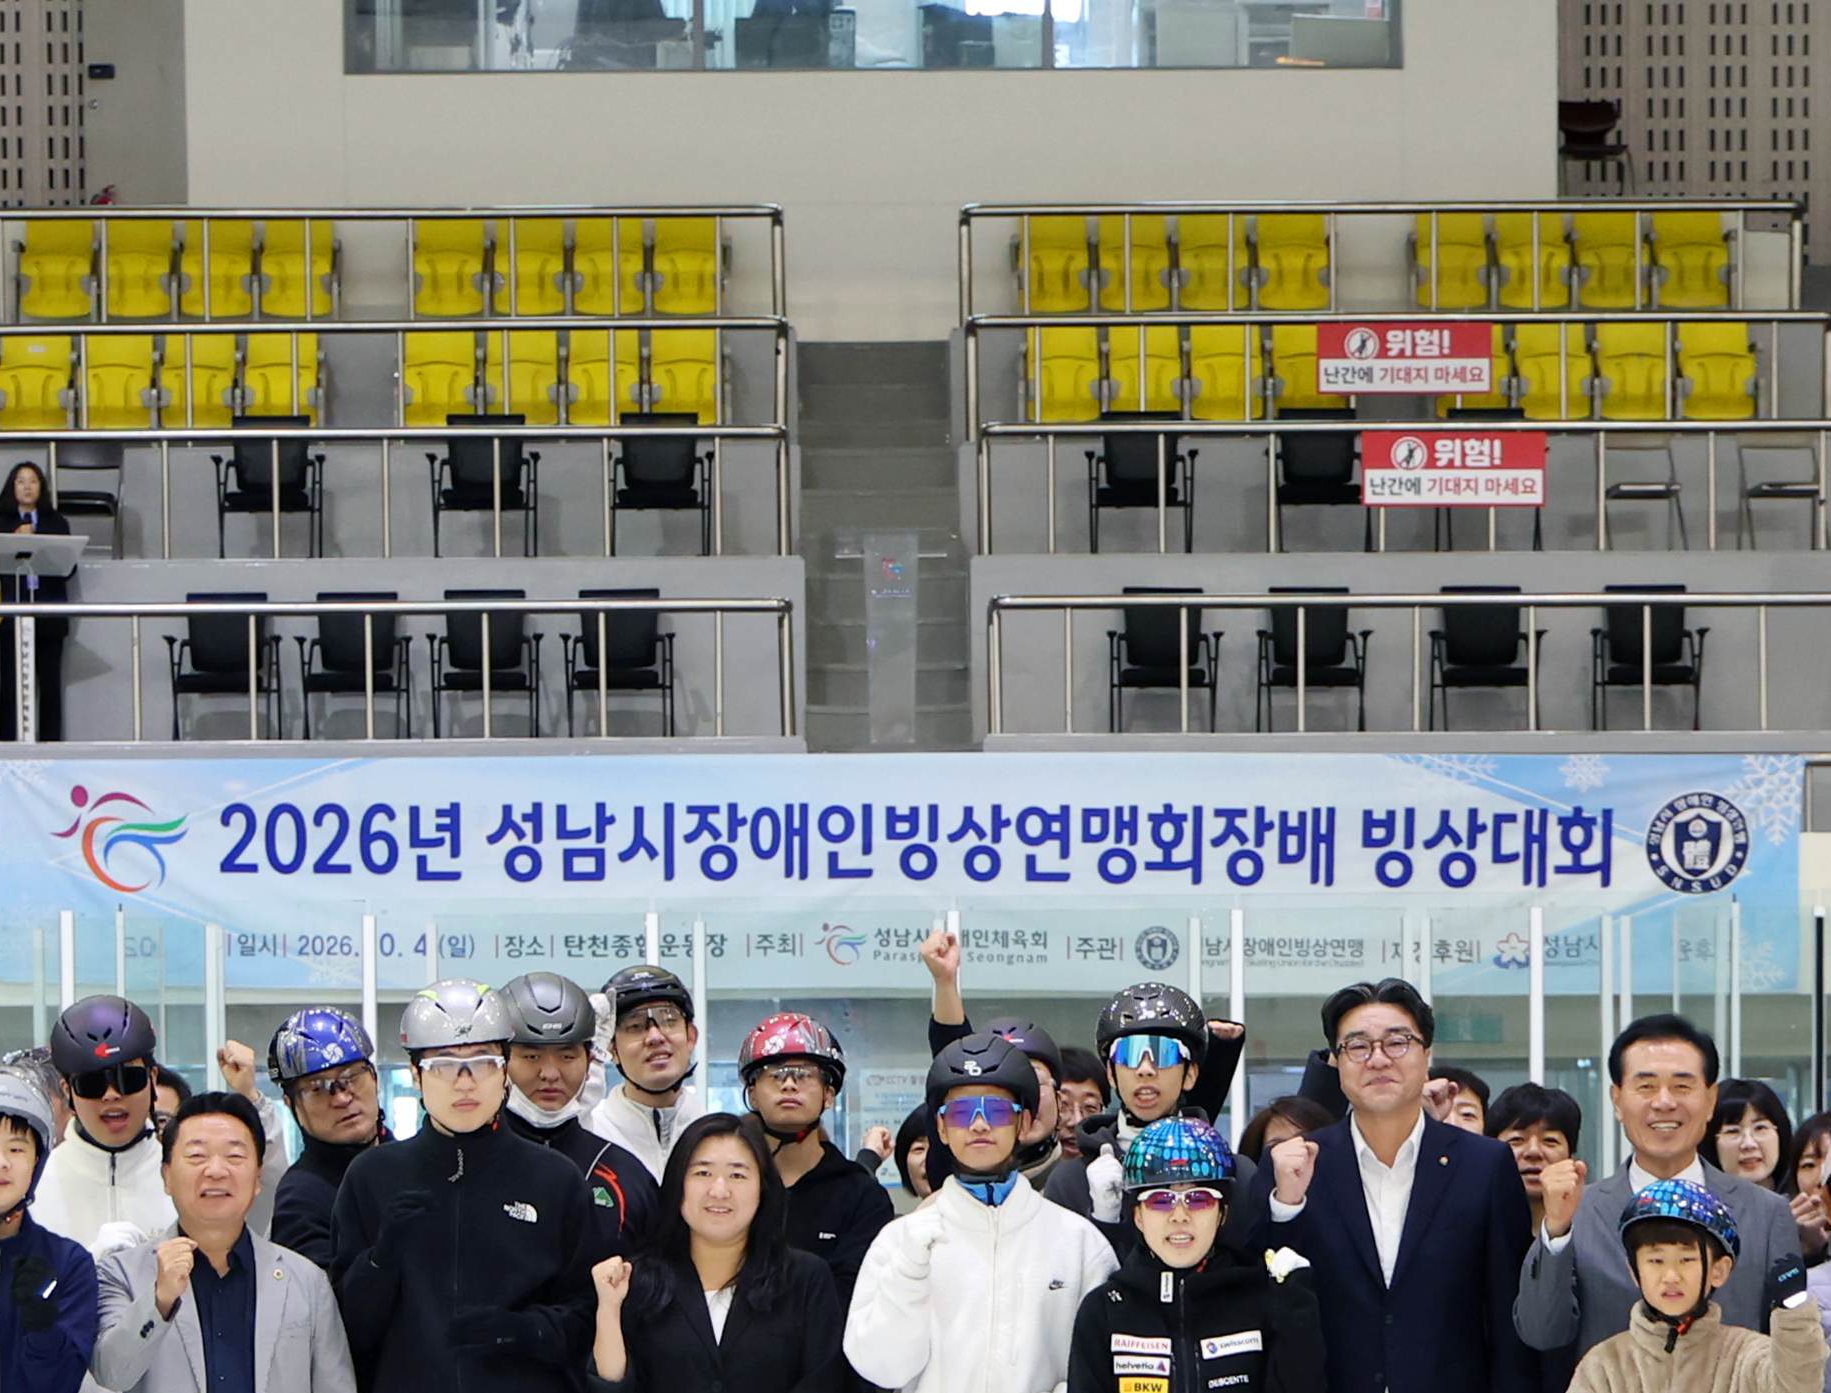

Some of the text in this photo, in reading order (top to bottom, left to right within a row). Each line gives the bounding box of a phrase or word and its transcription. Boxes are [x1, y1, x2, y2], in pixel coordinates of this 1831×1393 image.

[1385, 329, 1451, 357] 위험!
[1324, 366, 1485, 385] 난간에 기대지 마세요
[1434, 438, 1503, 467] 위험!
[1370, 477, 1537, 496] 난간에 기대지 마세요
[218, 800, 1614, 889] 2026년 성남시장애인빙상연맹회장배 빙상대회
[237, 934, 278, 957] 일시
[297, 935, 359, 957] 2026.
[438, 934, 475, 959] (일)
[504, 935, 545, 959] 장소
[755, 927, 1048, 958] 주최 성남시인체육회
[1075, 935, 1118, 960] 주관
[1201, 937, 1364, 958] 남장애인빙상연맹
[967, 952, 1048, 966] Seongnam
[1114, 1336, 1259, 1350] RAIFFEISEN swisscom
[1116, 1360, 1154, 1371] helvetia
[1134, 1382, 1162, 1393] BKW
[1208, 1374, 1250, 1389] DESCENTE
